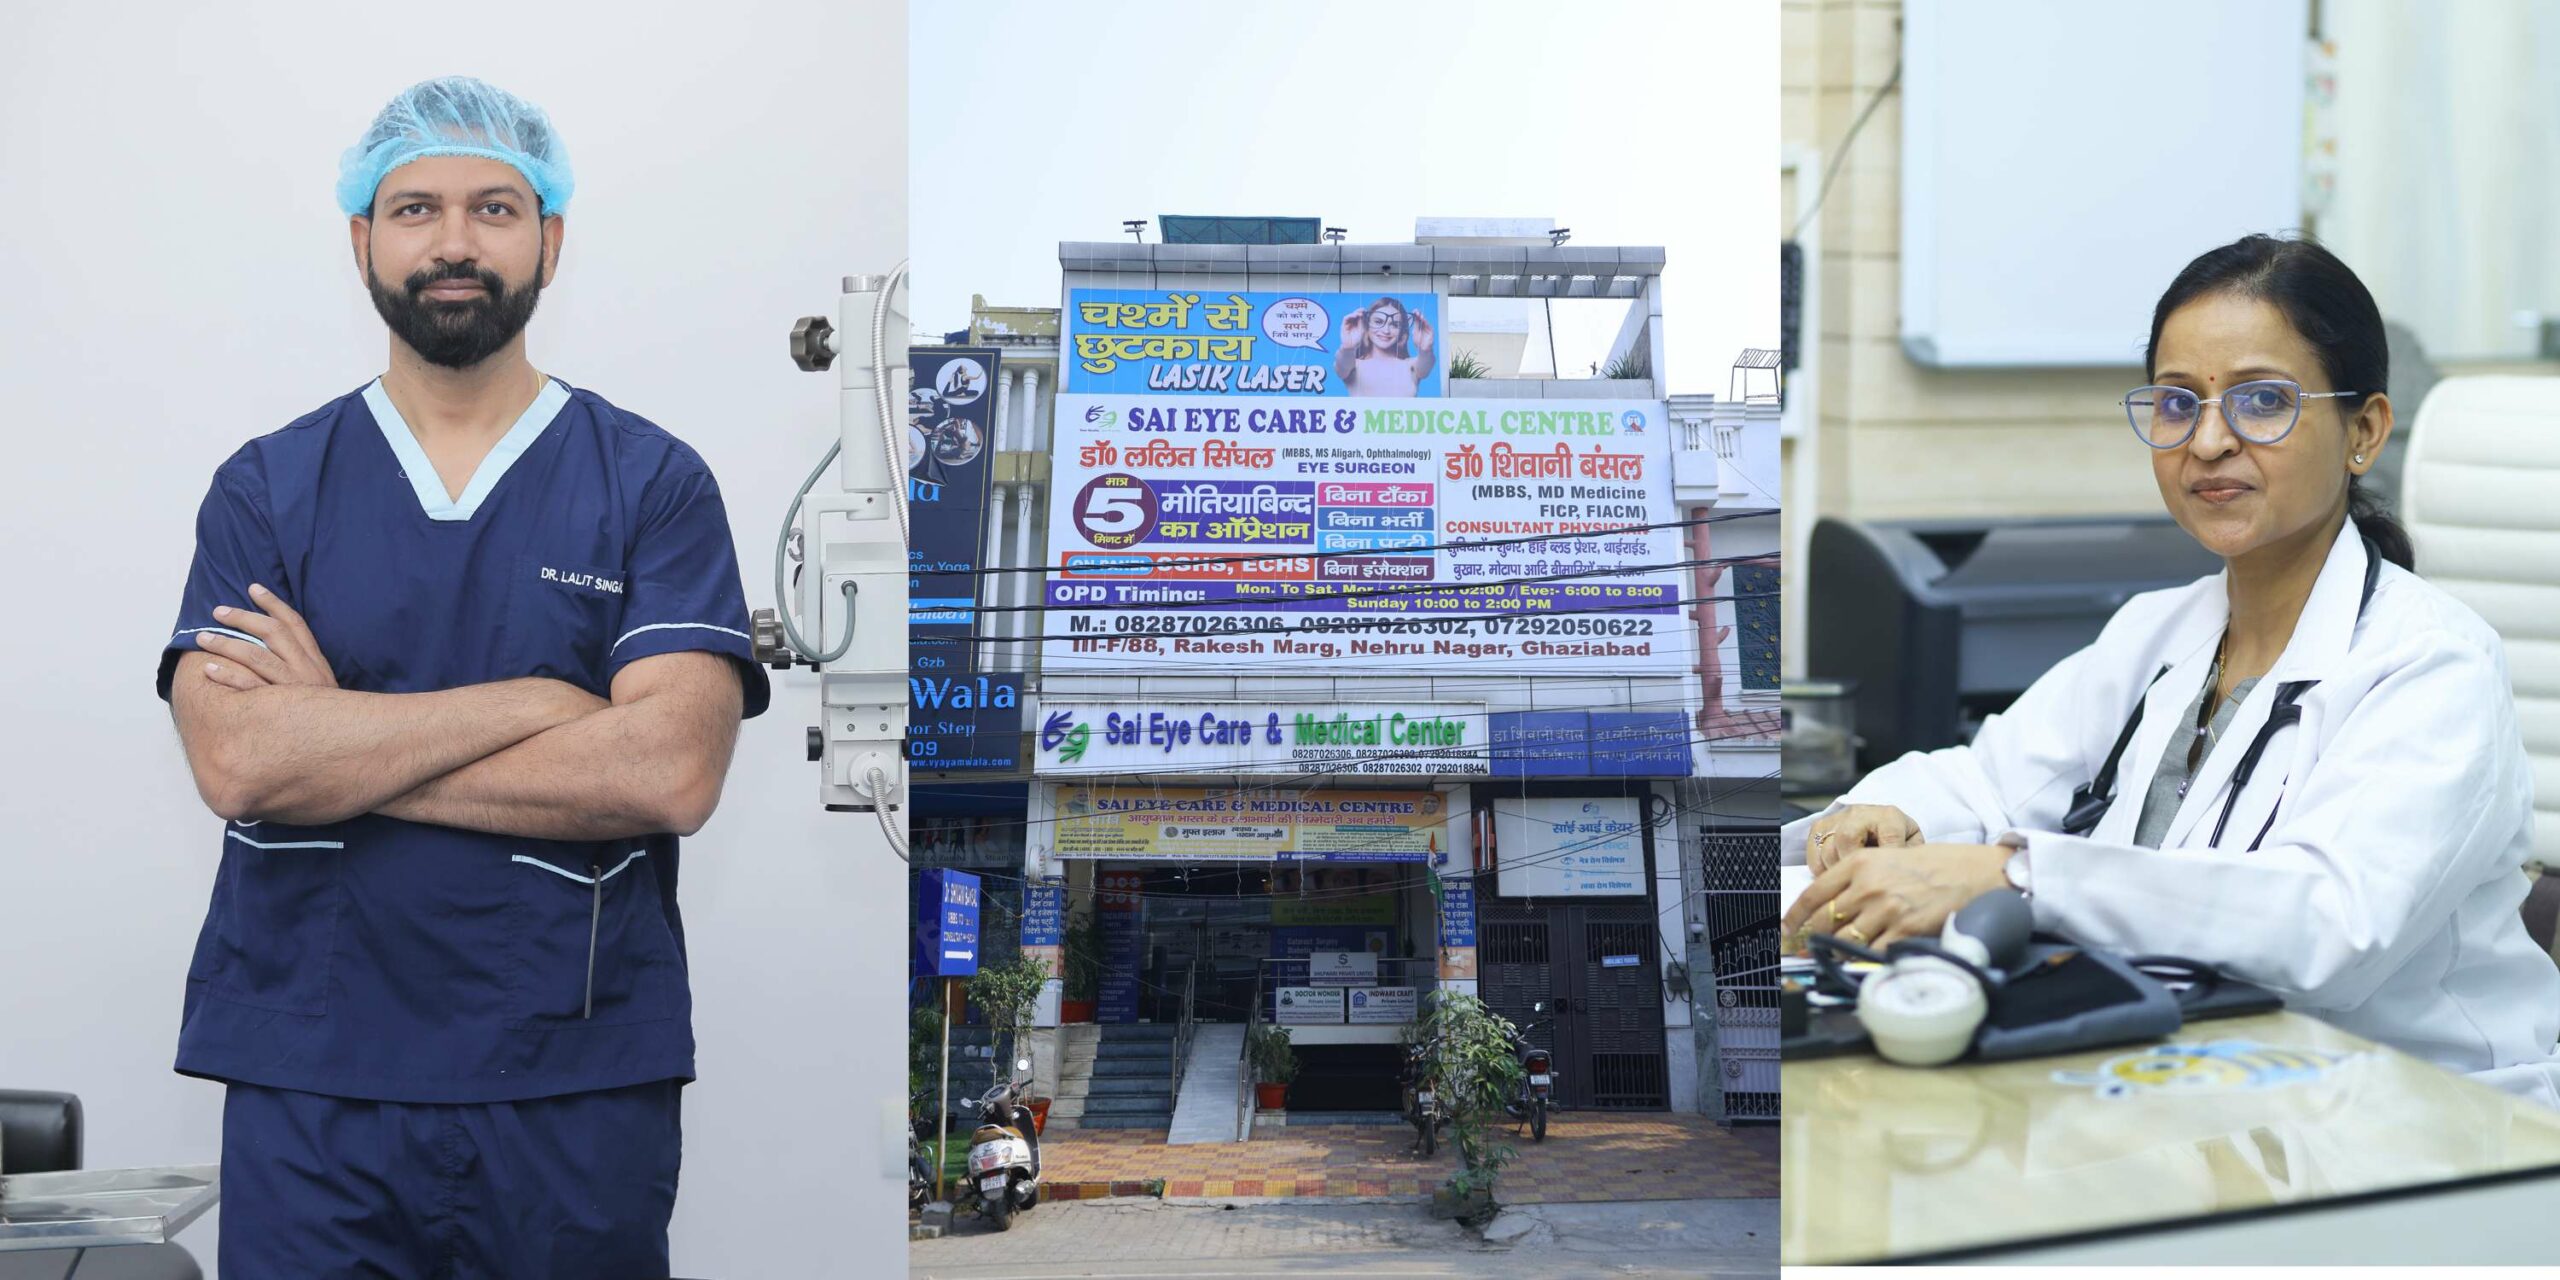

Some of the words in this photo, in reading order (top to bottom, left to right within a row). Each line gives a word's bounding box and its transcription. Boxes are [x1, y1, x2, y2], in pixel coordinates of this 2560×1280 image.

[1079, 294, 1201, 330] चश्में
[1204, 294, 1257, 330] से
[1074, 334, 1258, 375] छुटकारा
[1148, 363, 1238, 392] LASIK
[1238, 364, 1328, 394] LASER
[1127, 407, 1178, 434] SAI
[1184, 408, 1241, 433] EYE
[1248, 408, 1328, 434] CARE
[1334, 408, 1358, 434] &
[1363, 410, 1494, 435] MEDICAL
[1501, 410, 1616, 437] CENTRE
[1124, 438, 1198, 469] ललित
[1203, 438, 1276, 469] सिंघल
[1282, 448, 1314, 460] (MBBS,
[1316, 448, 1329, 458] MS
[1331, 448, 1364, 460] Aligarh,
[1367, 449, 1432, 461] Ophthalmology)
[1490, 441, 1574, 480] शिवानी
[1579, 443, 1646, 481] बंसल
[1298, 462, 1329, 473] EYE
[1335, 462, 1416, 474] SURGEON
[1105, 476, 1129, 488] मात्र
[1161, 484, 1315, 517] मोतियाबिन्द
[1323, 484, 1374, 504] बिना
[1472, 485, 1532, 501] (MBBS,
[1538, 486, 1565, 499] MD
[1570, 485, 1646, 500] Medicine
[1082, 487, 1146, 534] 5
[1328, 510, 1378, 528] बिना
[1380, 510, 1425, 529] भर्ती
[1540, 505, 1582, 521] FICP,
[1586, 505, 1648, 521] FIACM)
[1160, 520, 1199, 540] का
[1205, 516, 1310, 544] ऑप्रेशन
[1446, 521, 1555, 534] CONSULTANT
[1093, 532, 1122, 545] मिनट
[1123, 532, 1135, 545] में
[1324, 533, 1374, 551] बिना
[1241, 556, 1311, 574] ECHS
[1323, 561, 1360, 576] बिना
[1489, 560, 1522, 576] मोटापा
[1524, 559, 1549, 576] आदि
[541, 566, 559, 581] DR.
[561, 570, 594, 587] LALIT
[1055, 585, 1107, 602] OPD
[1115, 585, 1206, 603] Timing:
[1236, 584, 1277, 595] Mon.
[1280, 584, 1300, 595] To
[1303, 584, 1337, 595] Sat.
[1520, 587, 1560, 597] Eve:-
[1565, 587, 1601, 597] 6:00
[1605, 587, 1622, 597] to
[1626, 588, 1663, 598] 8:00
[1347, 598, 1408, 611] Sunday
[1414, 598, 1459, 609] 10:00
[1464, 599, 1481, 609] to
[1485, 599, 1521, 610] 2:00
[1526, 599, 1552, 610] PM
[1115, 614, 1291, 637] 08287026306,
[1485, 618, 1653, 637] 07292050622
[1174, 638, 1265, 655] Rakesh
[1273, 639, 1342, 658] Marg,
[1351, 639, 1425, 656] Nehru
[1433, 640, 1513, 659] Nagar,
[1521, 641, 1652, 658] Ghaziabad
[917, 656, 945, 669] Gzb
[909, 677, 1016, 710] Wala
[938, 721, 976, 737] Step
[1106, 711, 1142, 746] Sai
[1150, 711, 1192, 754] Eye
[1199, 711, 1253, 746] Care
[1266, 711, 1283, 746] &
[1295, 711, 1382, 746] Medical
[1390, 711, 1467, 746] Center
[1097, 799, 1130, 811] SAI
[1134, 799, 1170, 811] EYE
[1175, 799, 1227, 812] CARE
[1231, 800, 1245, 812] &
[1250, 801, 1335, 813] MEDICAL
[1339, 802, 1415, 814] CENTRE
